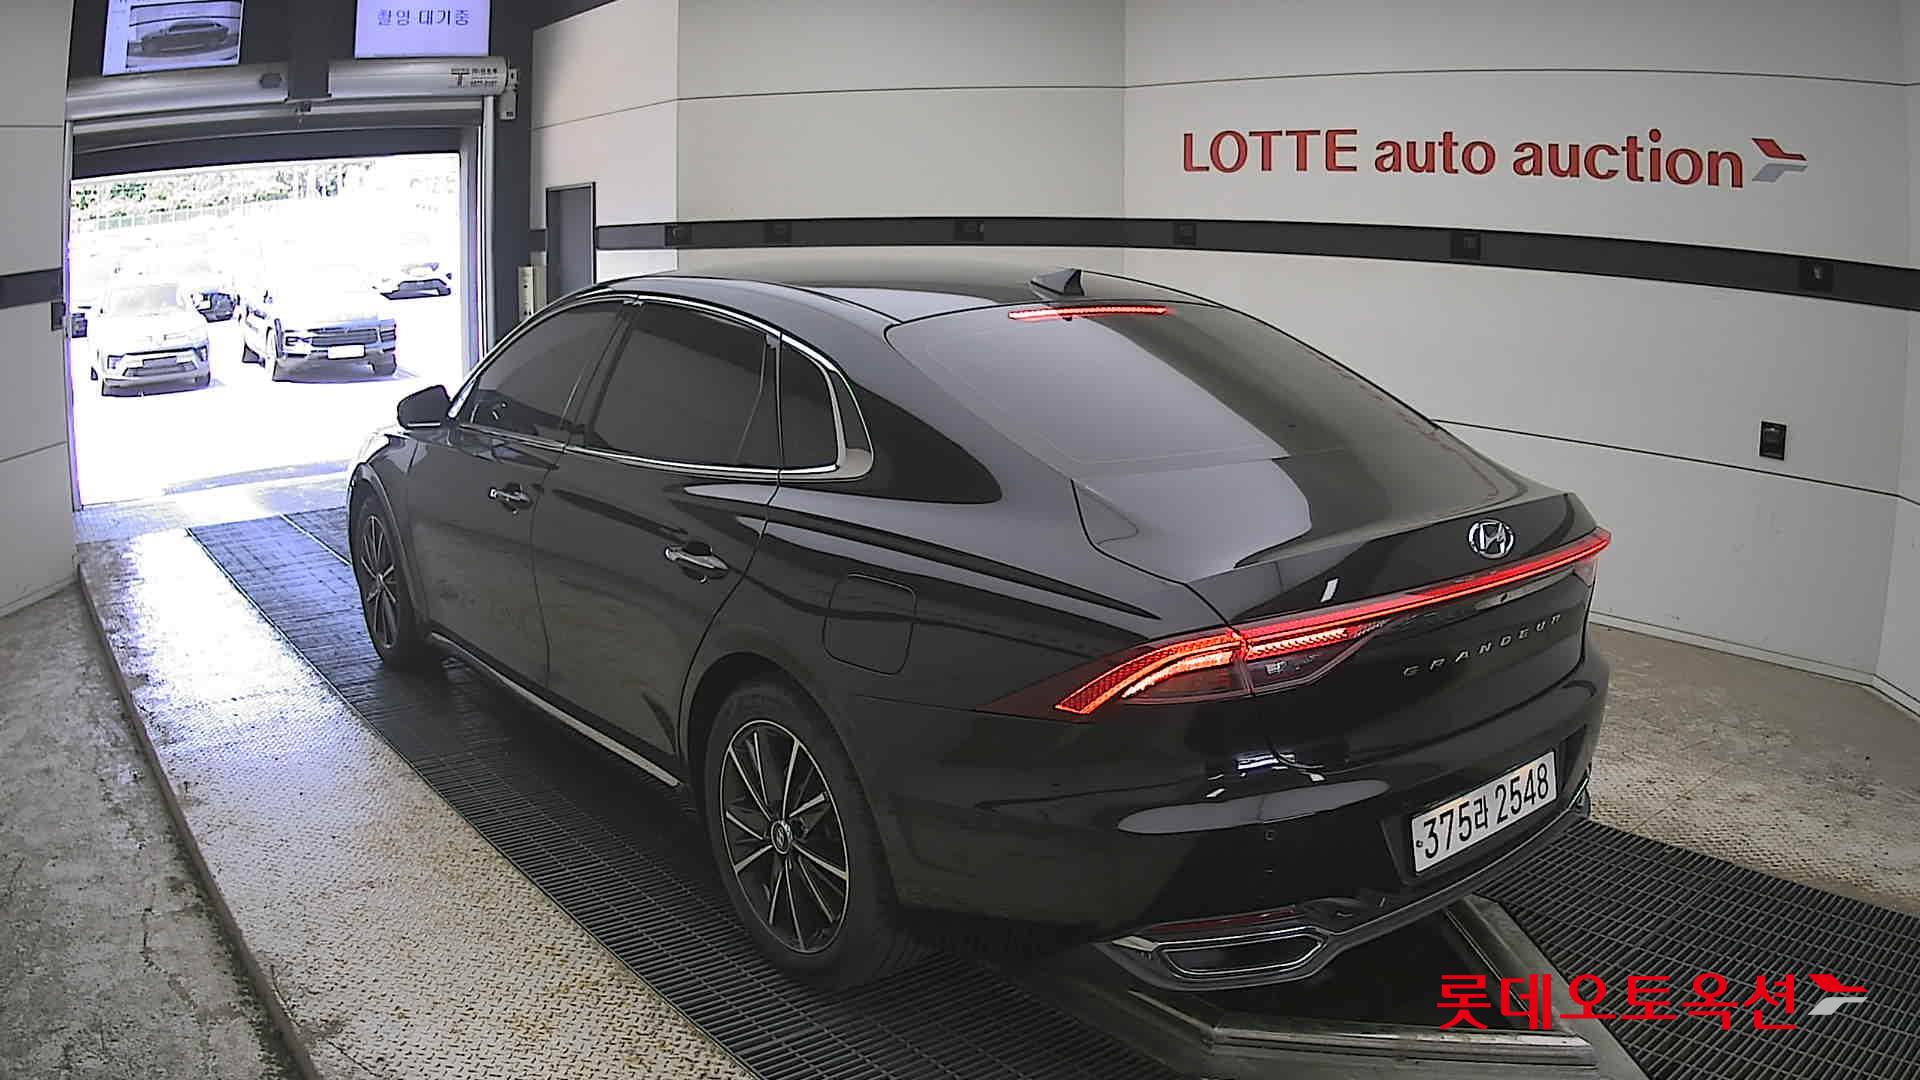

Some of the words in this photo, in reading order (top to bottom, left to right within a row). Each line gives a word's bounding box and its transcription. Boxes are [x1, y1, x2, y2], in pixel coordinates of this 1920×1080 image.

[418, 9, 469, 26] 대기중
[1183, 129, 1358, 172] LOTTE
[1374, 132, 1495, 175] auto
[1513, 128, 1744, 188] auction
[1402, 613, 1561, 676] GRANDEUR
[1423, 795, 1488, 859] 375라
[1495, 763, 1549, 825] 2548
